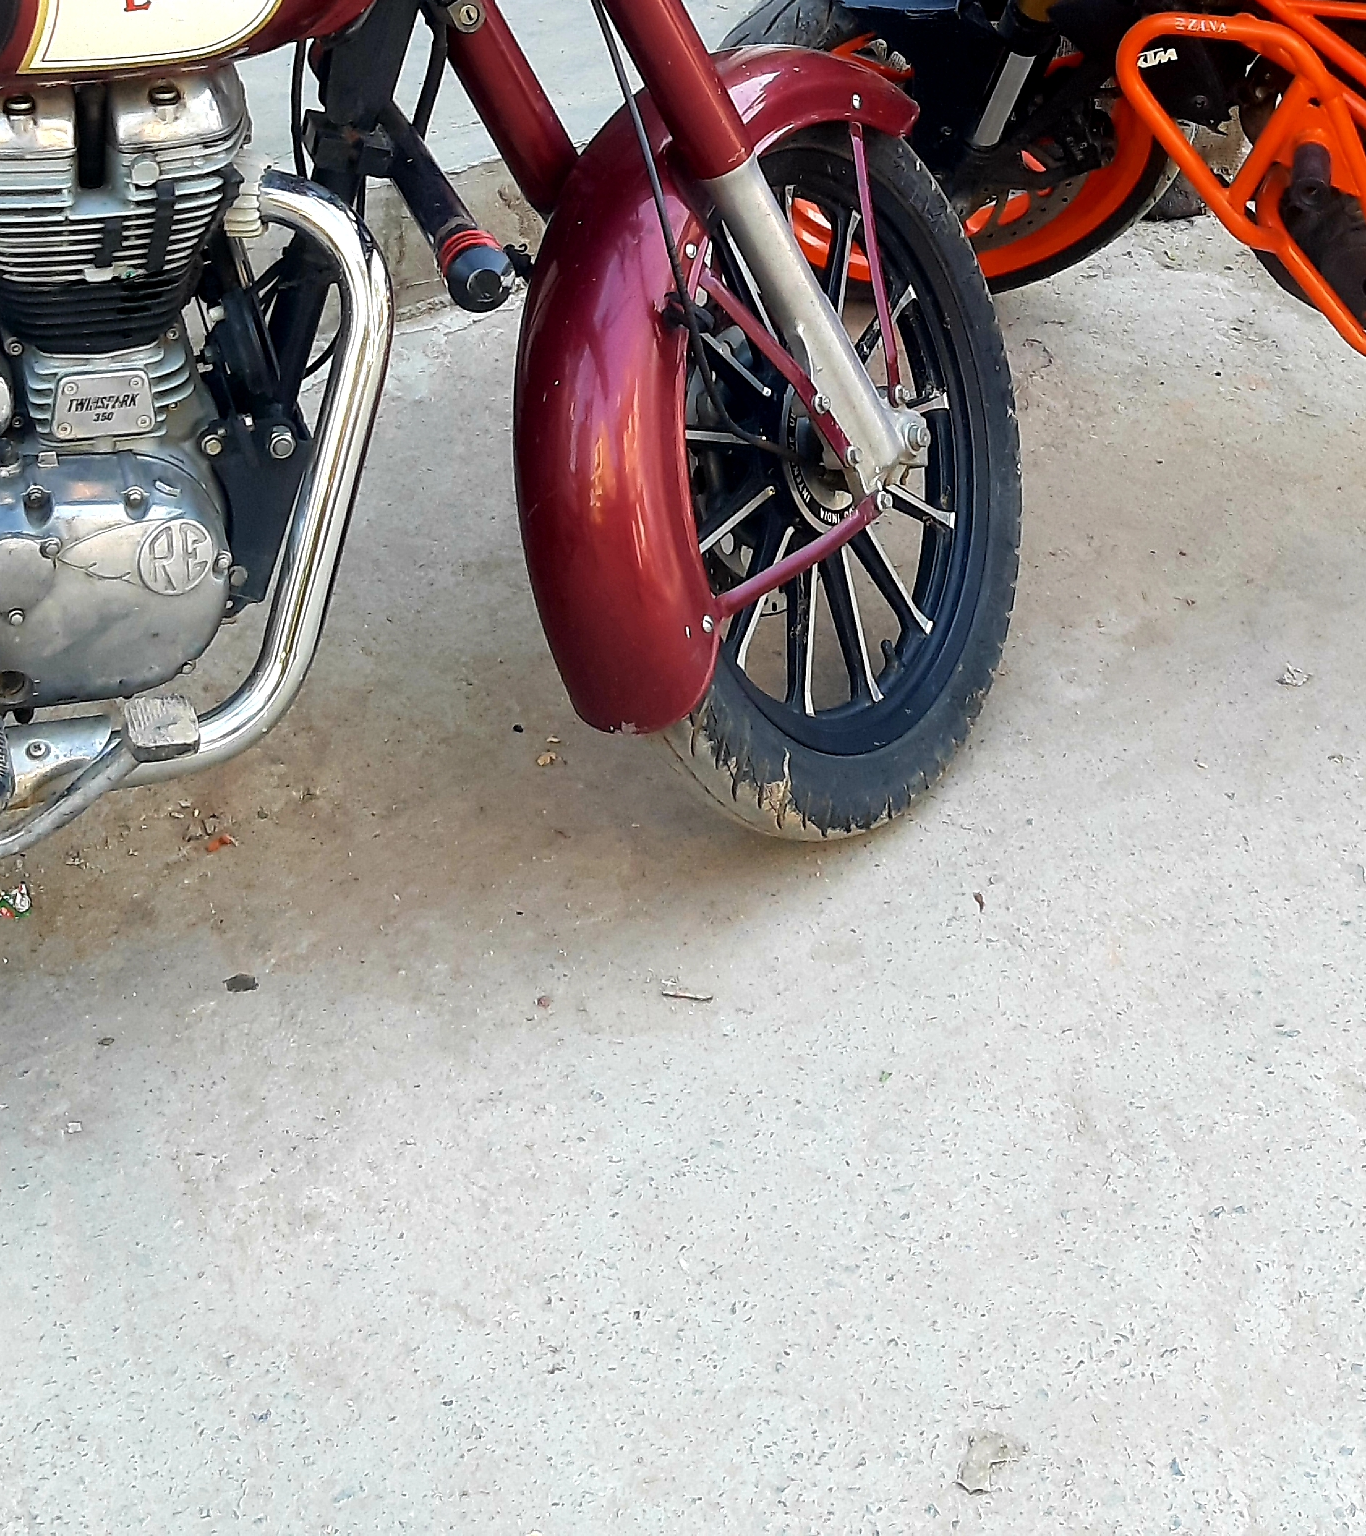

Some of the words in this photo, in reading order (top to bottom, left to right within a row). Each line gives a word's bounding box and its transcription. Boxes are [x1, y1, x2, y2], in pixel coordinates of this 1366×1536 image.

[1137, 47, 1178, 69] KTM
[66, 392, 141, 414] TWINSPARK
[92, 410, 115, 422] 350
